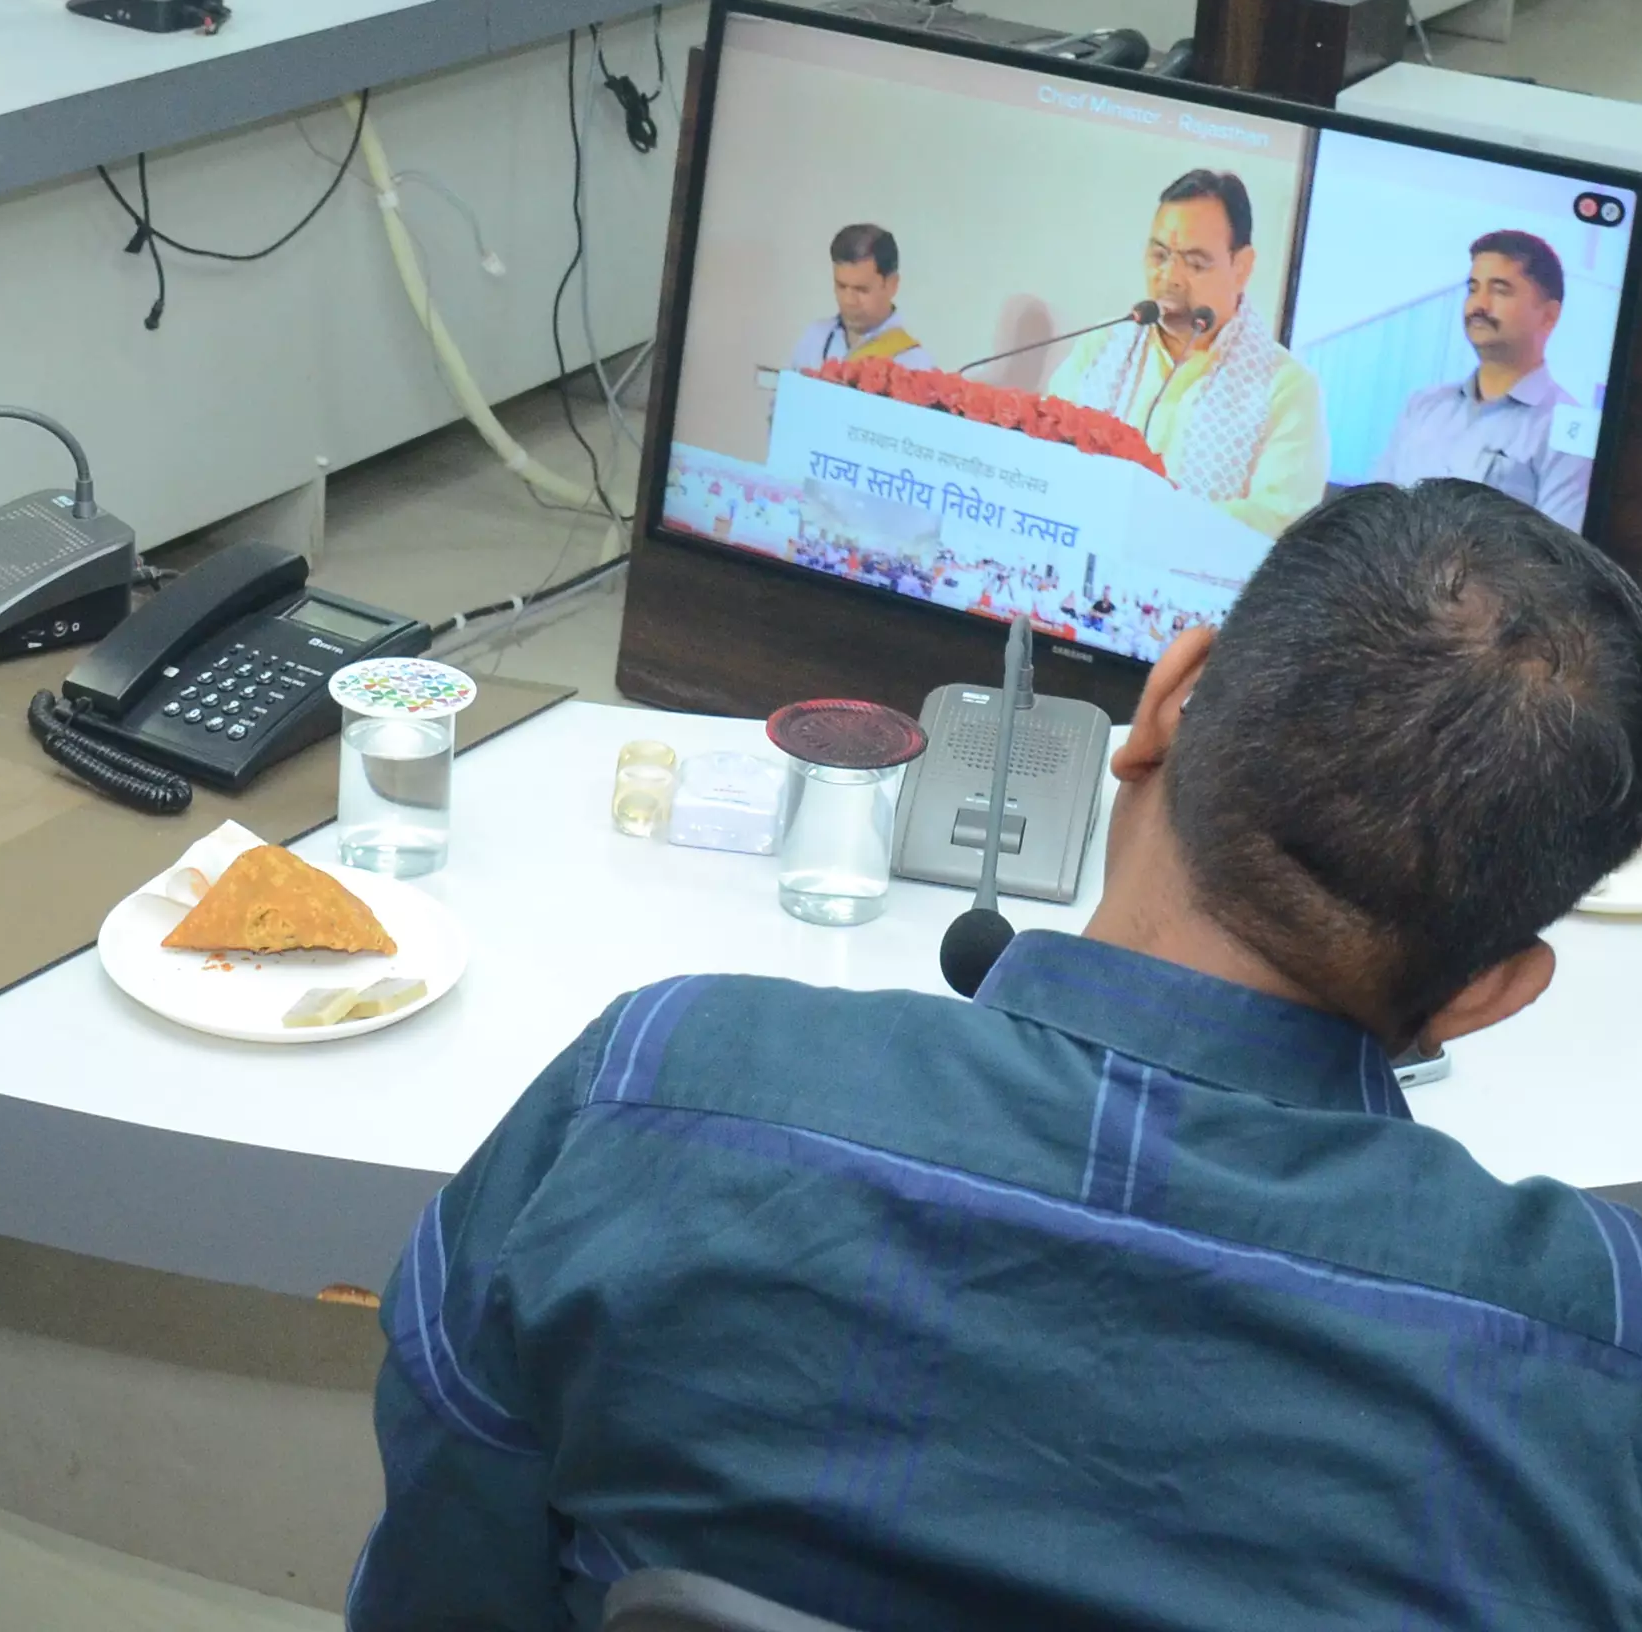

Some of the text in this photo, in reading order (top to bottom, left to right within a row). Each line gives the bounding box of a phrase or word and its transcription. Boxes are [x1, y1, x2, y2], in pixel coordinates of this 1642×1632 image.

[1090, 95, 1160, 124] Minister
[1178, 113, 1271, 147] Rajasthan
[809, 450, 1081, 548] राज्य स्तरीय निवेश उत्सव
